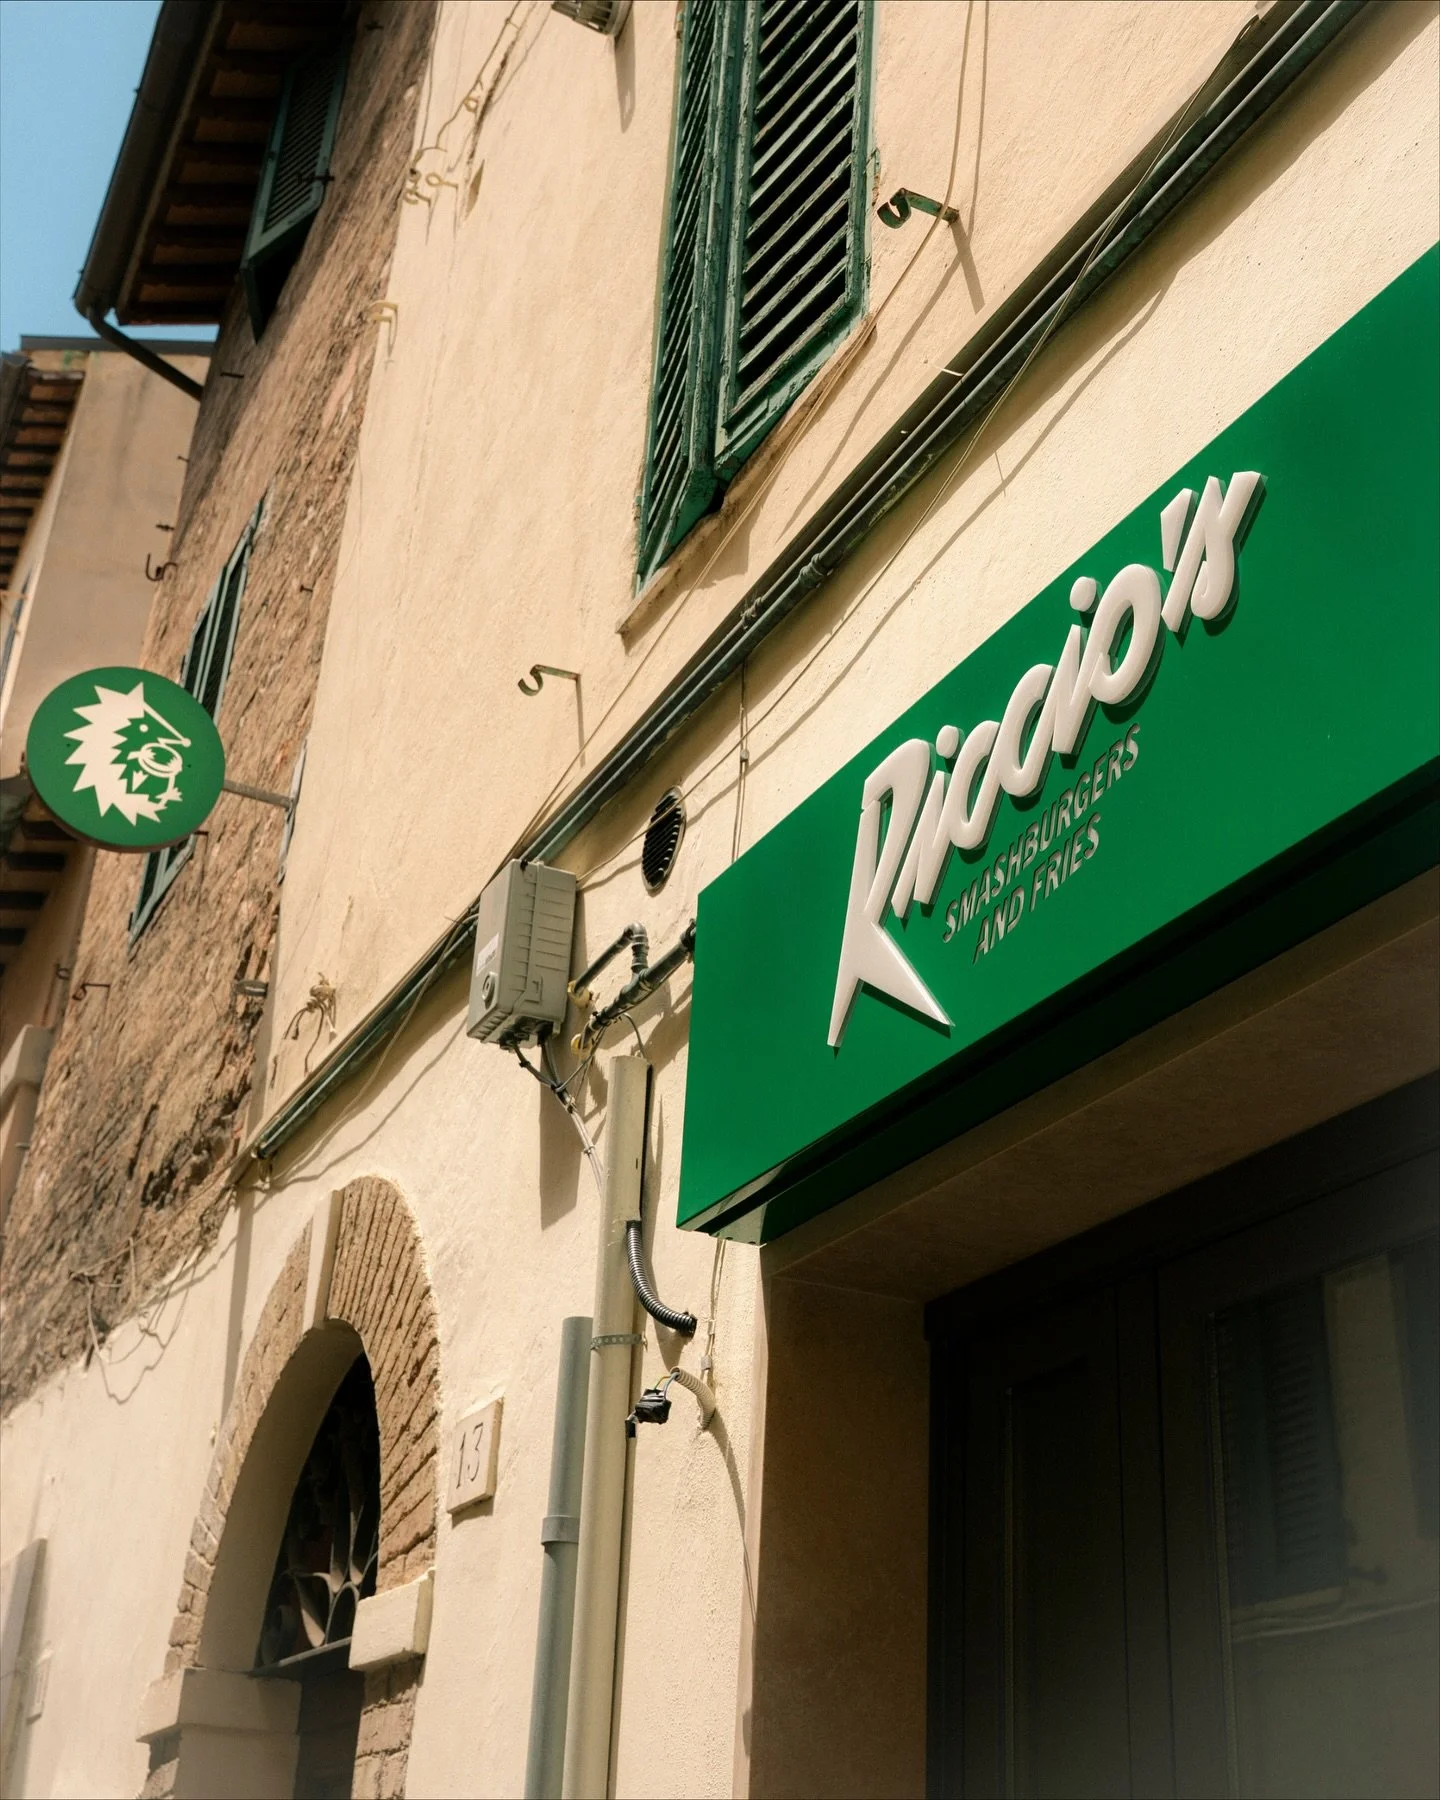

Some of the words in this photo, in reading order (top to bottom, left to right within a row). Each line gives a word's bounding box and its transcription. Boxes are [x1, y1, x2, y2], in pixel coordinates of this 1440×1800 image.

[828, 471, 1267, 1047] Riccio's
[943, 723, 1140, 943] SMASHBURGERS
[973, 885, 1025, 965] AND
[1029, 812, 1101, 913] FRIES
[456, 1422, 484, 1489] 13
